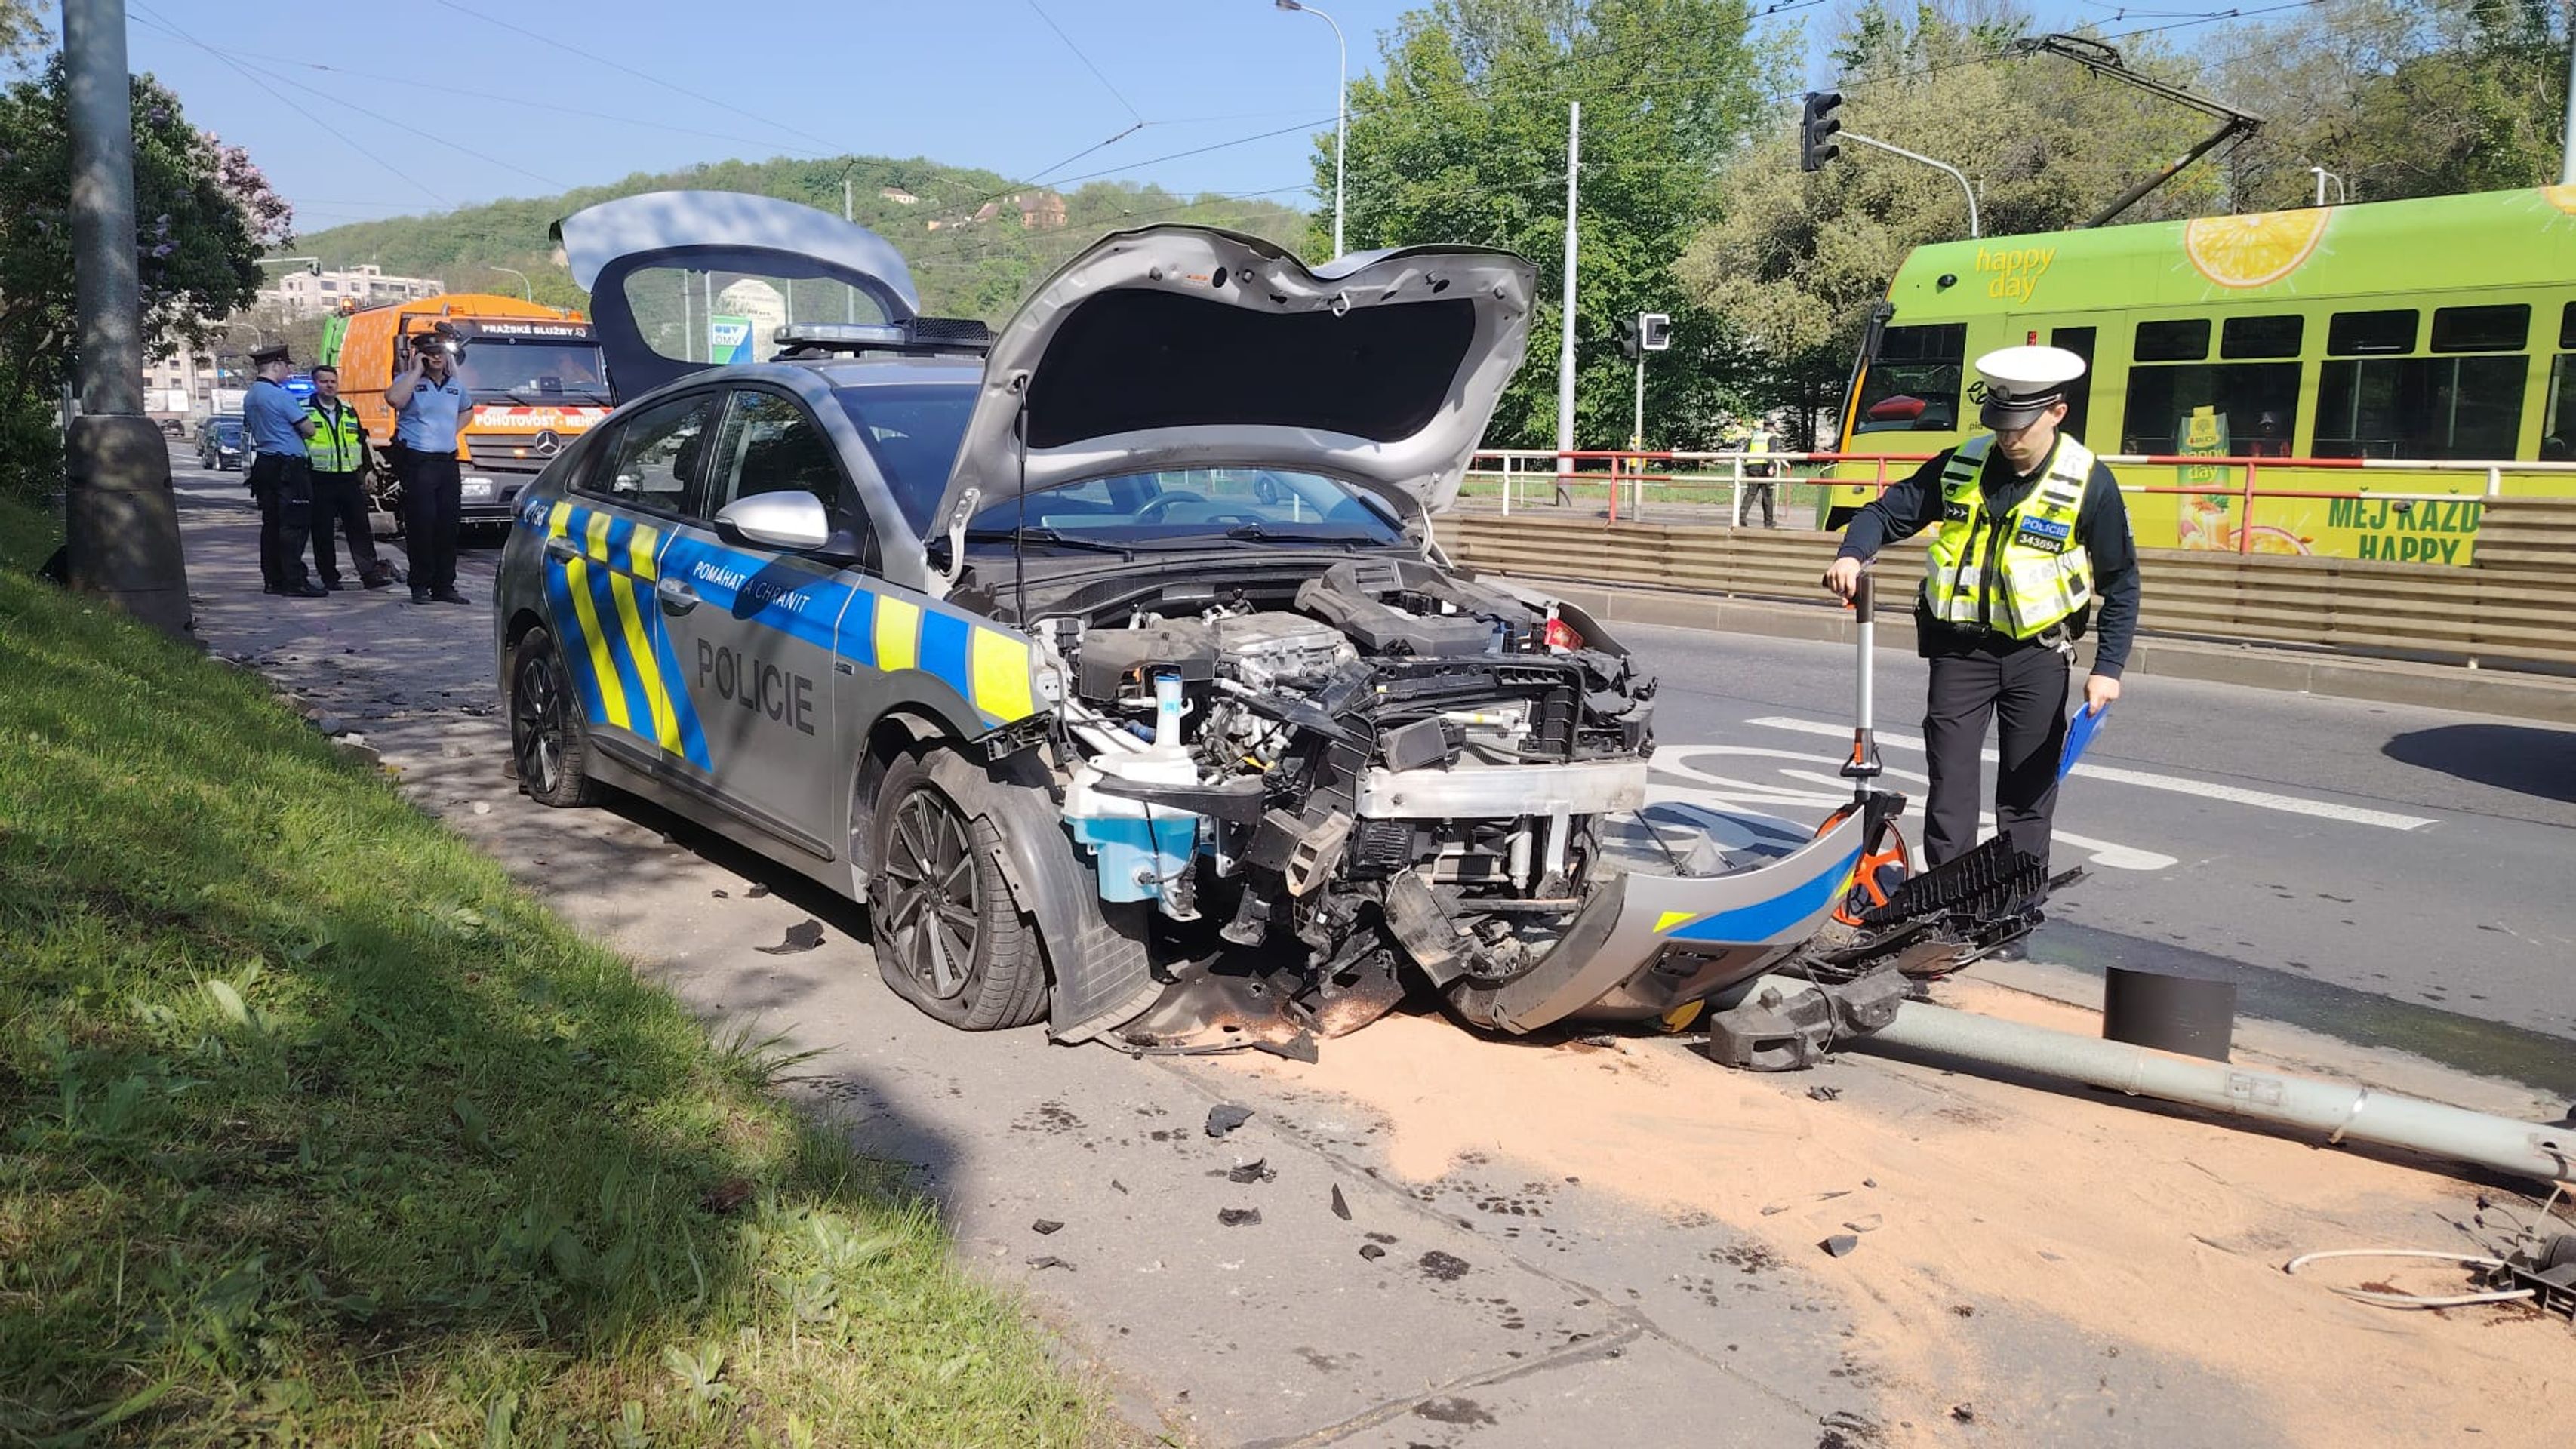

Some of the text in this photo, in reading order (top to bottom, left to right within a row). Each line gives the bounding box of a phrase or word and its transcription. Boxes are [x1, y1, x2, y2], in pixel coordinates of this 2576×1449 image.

[1976, 246, 2057, 278] happy
[1988, 271, 2038, 305] day
[482, 323, 574, 337] PRAŽSKÉ SLUŽBY
[475, 414, 556, 428] POHOTOVOST
[2021, 517, 2069, 537] POLICIE
[2359, 534, 2461, 565] HAPPY
[693, 561, 747, 592] POMÁHAT
[697, 638, 815, 736] POLICIE
